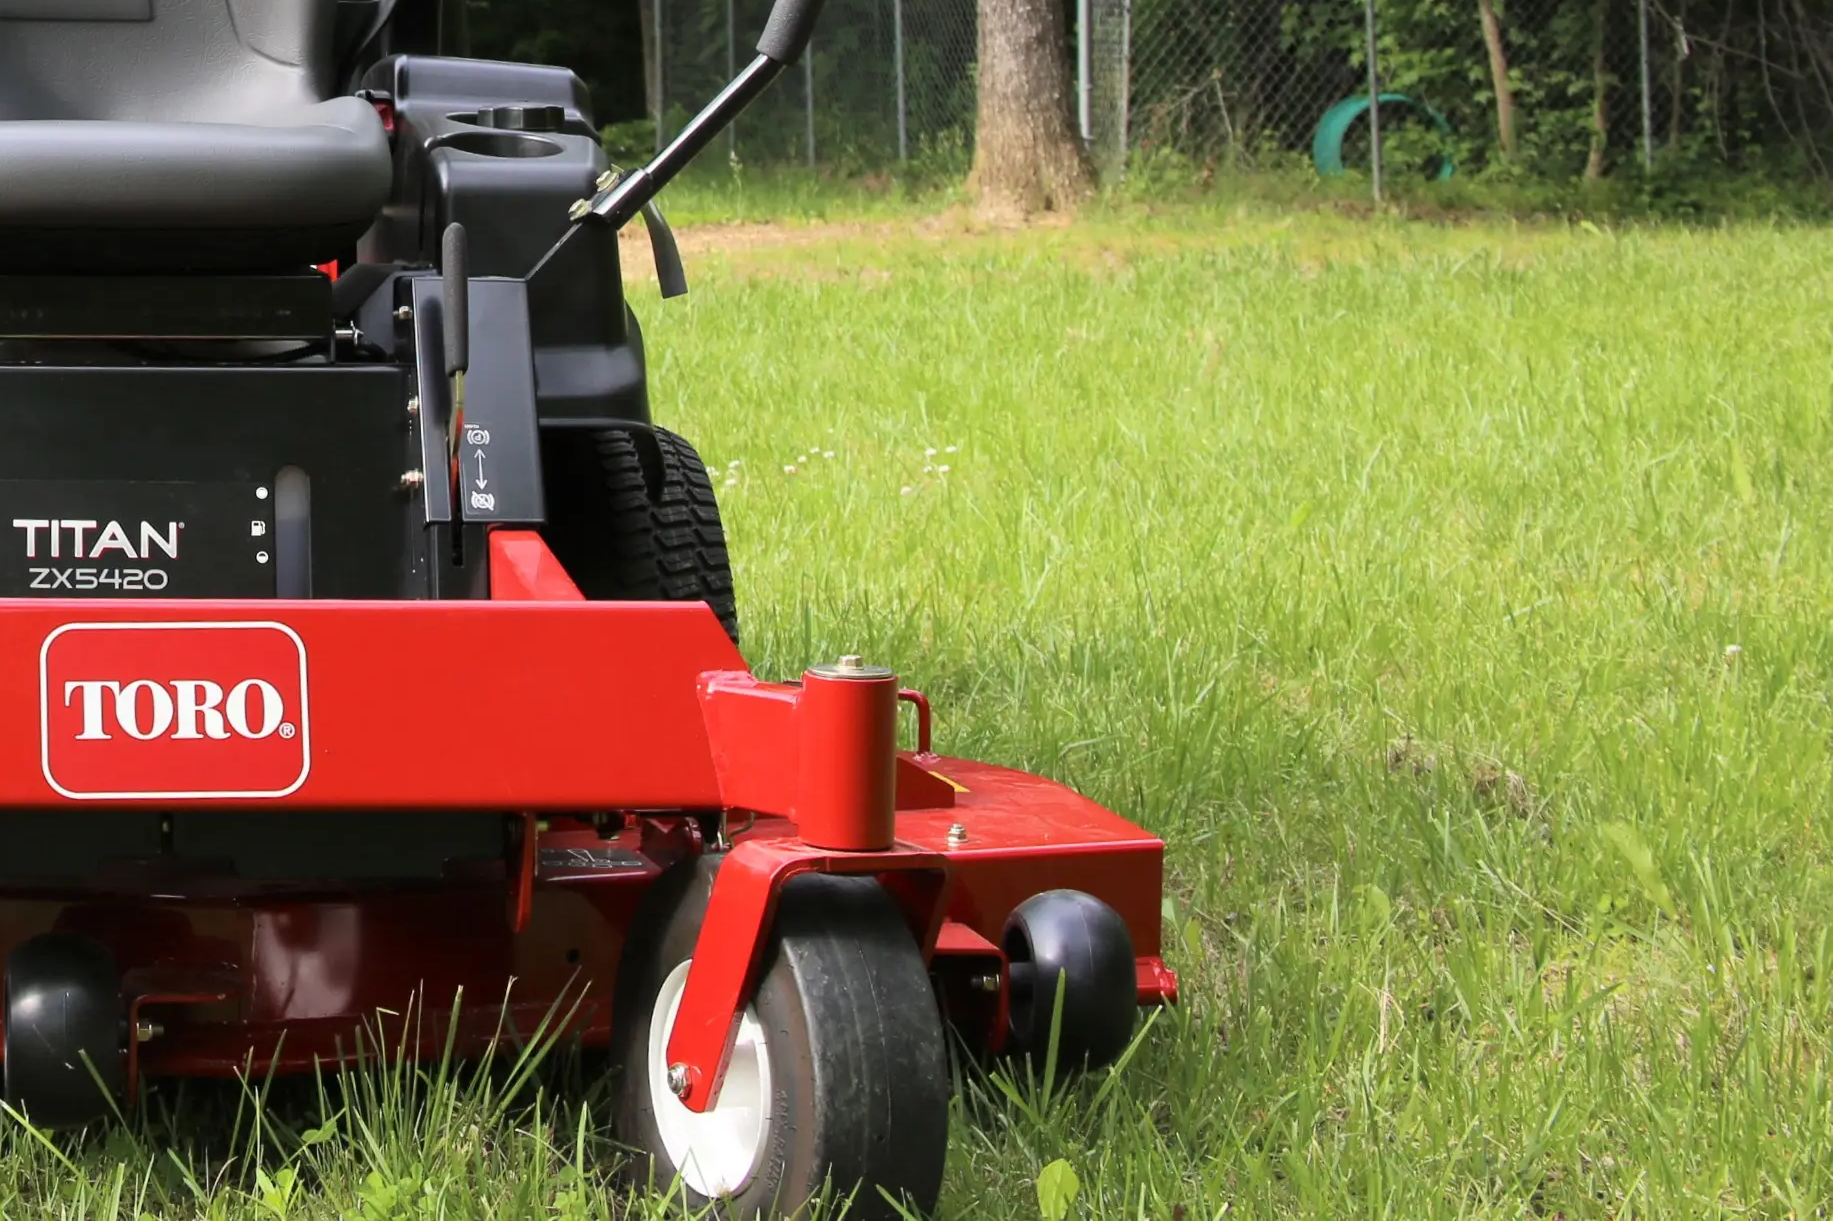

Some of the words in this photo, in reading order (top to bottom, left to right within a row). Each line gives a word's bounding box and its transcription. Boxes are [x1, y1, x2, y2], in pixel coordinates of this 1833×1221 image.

[12, 518, 179, 560] TITAN
[28, 567, 169, 591] ZX5420
[63, 678, 285, 741] TORO
